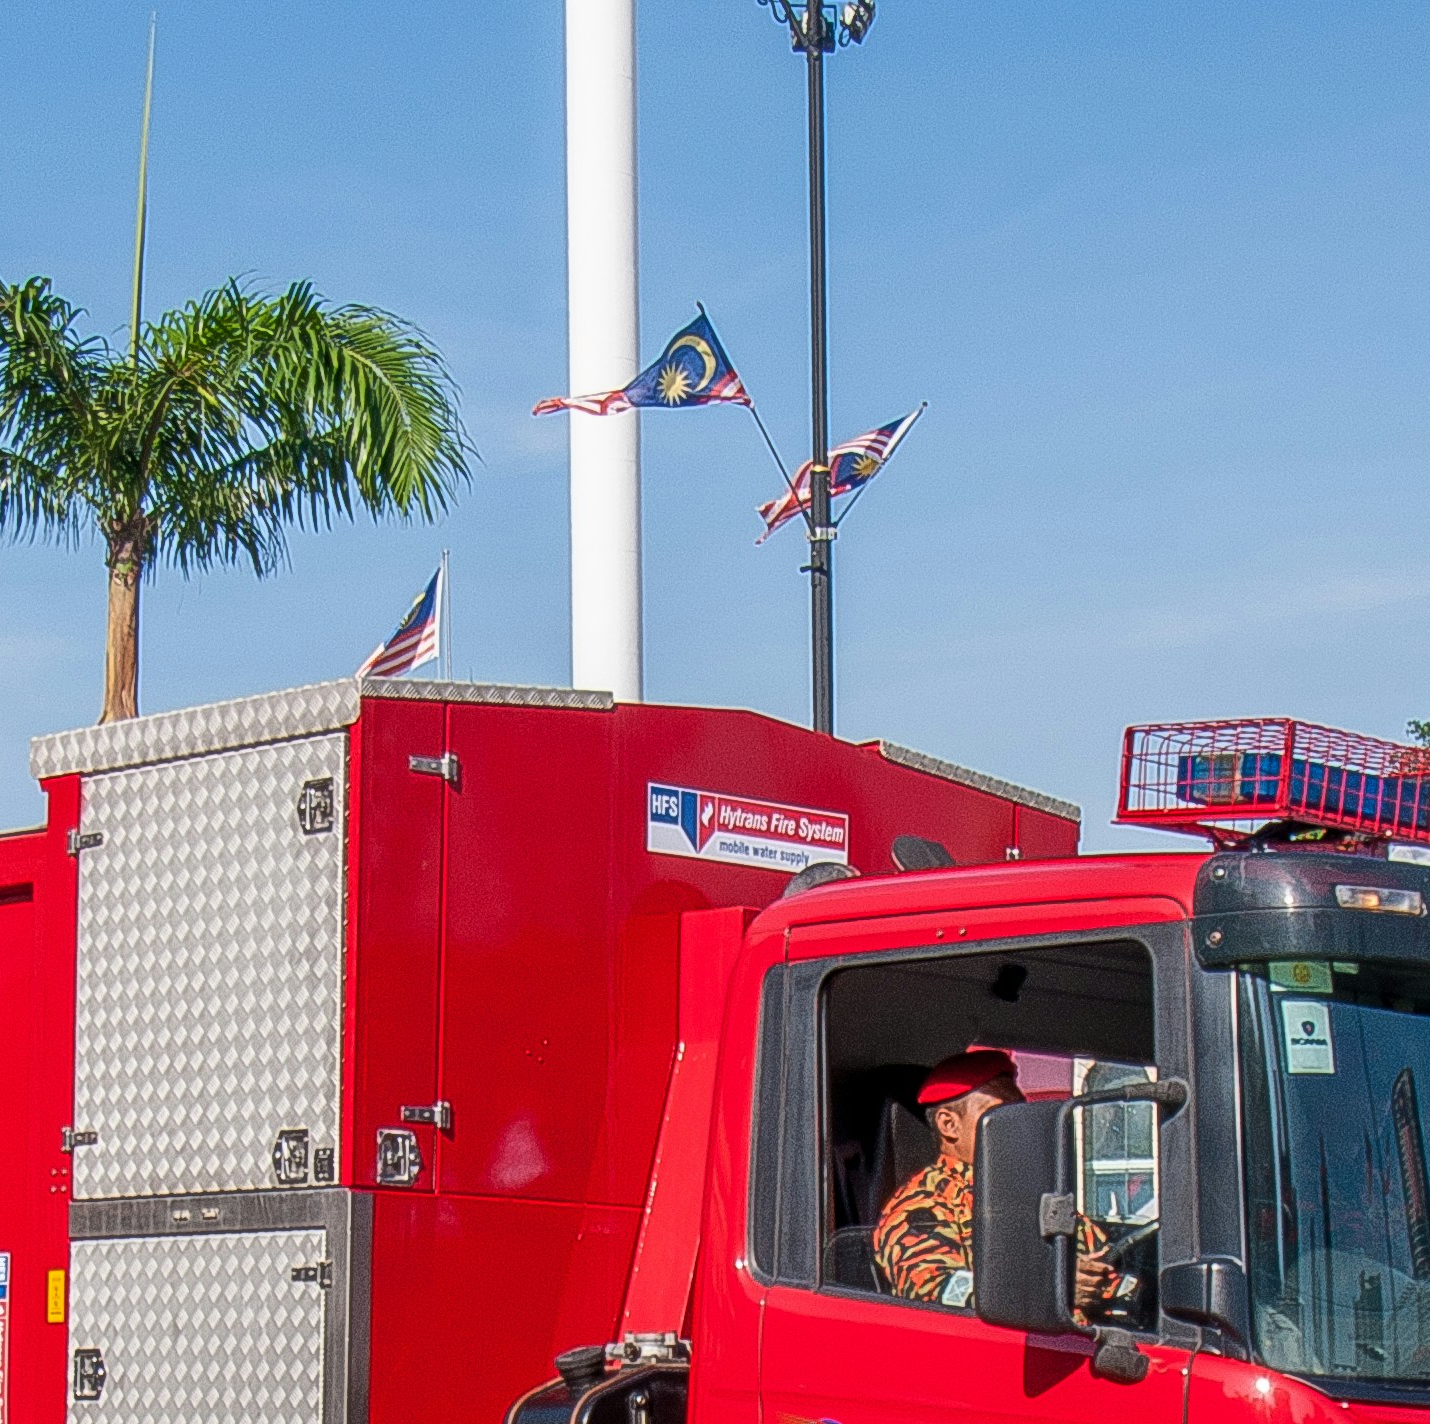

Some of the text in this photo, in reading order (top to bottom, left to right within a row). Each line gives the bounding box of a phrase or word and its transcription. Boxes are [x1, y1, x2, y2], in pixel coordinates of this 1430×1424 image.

[652, 793, 678, 817] HFS
[719, 804, 844, 843] Hytrans Fire System
[719, 840, 810, 867] mobile water supply
